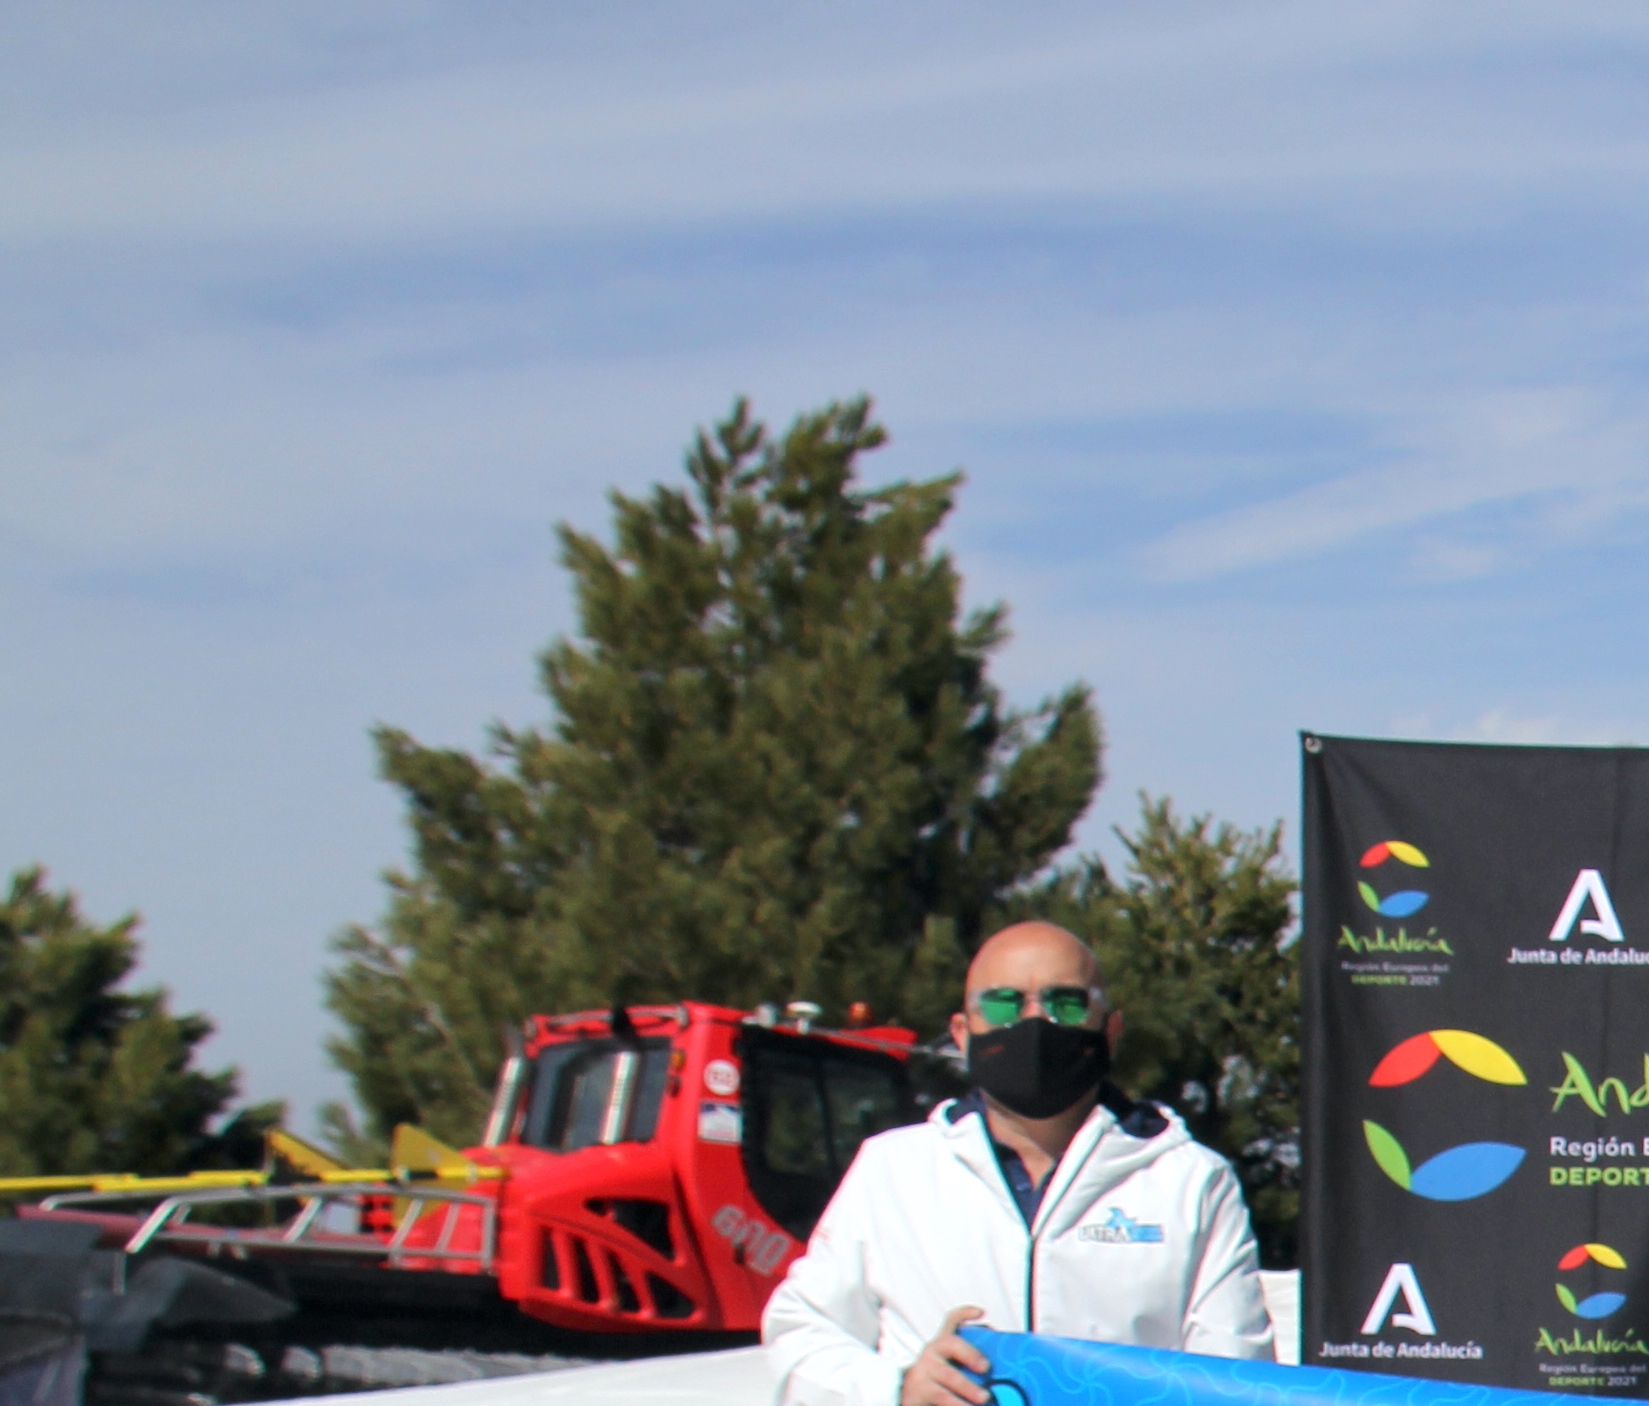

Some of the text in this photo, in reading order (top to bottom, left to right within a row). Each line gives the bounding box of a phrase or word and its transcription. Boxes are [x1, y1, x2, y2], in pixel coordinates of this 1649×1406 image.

[1337, 925, 1454, 955] Andalucía
[1507, 947, 1558, 964] Junta
[1560, 947, 1582, 964] de
[1550, 1136, 1635, 1162] Región
[1319, 1341, 1483, 1359] Junta de Andalucía
[1549, 1376, 1637, 1386] DEPORTE 2021
